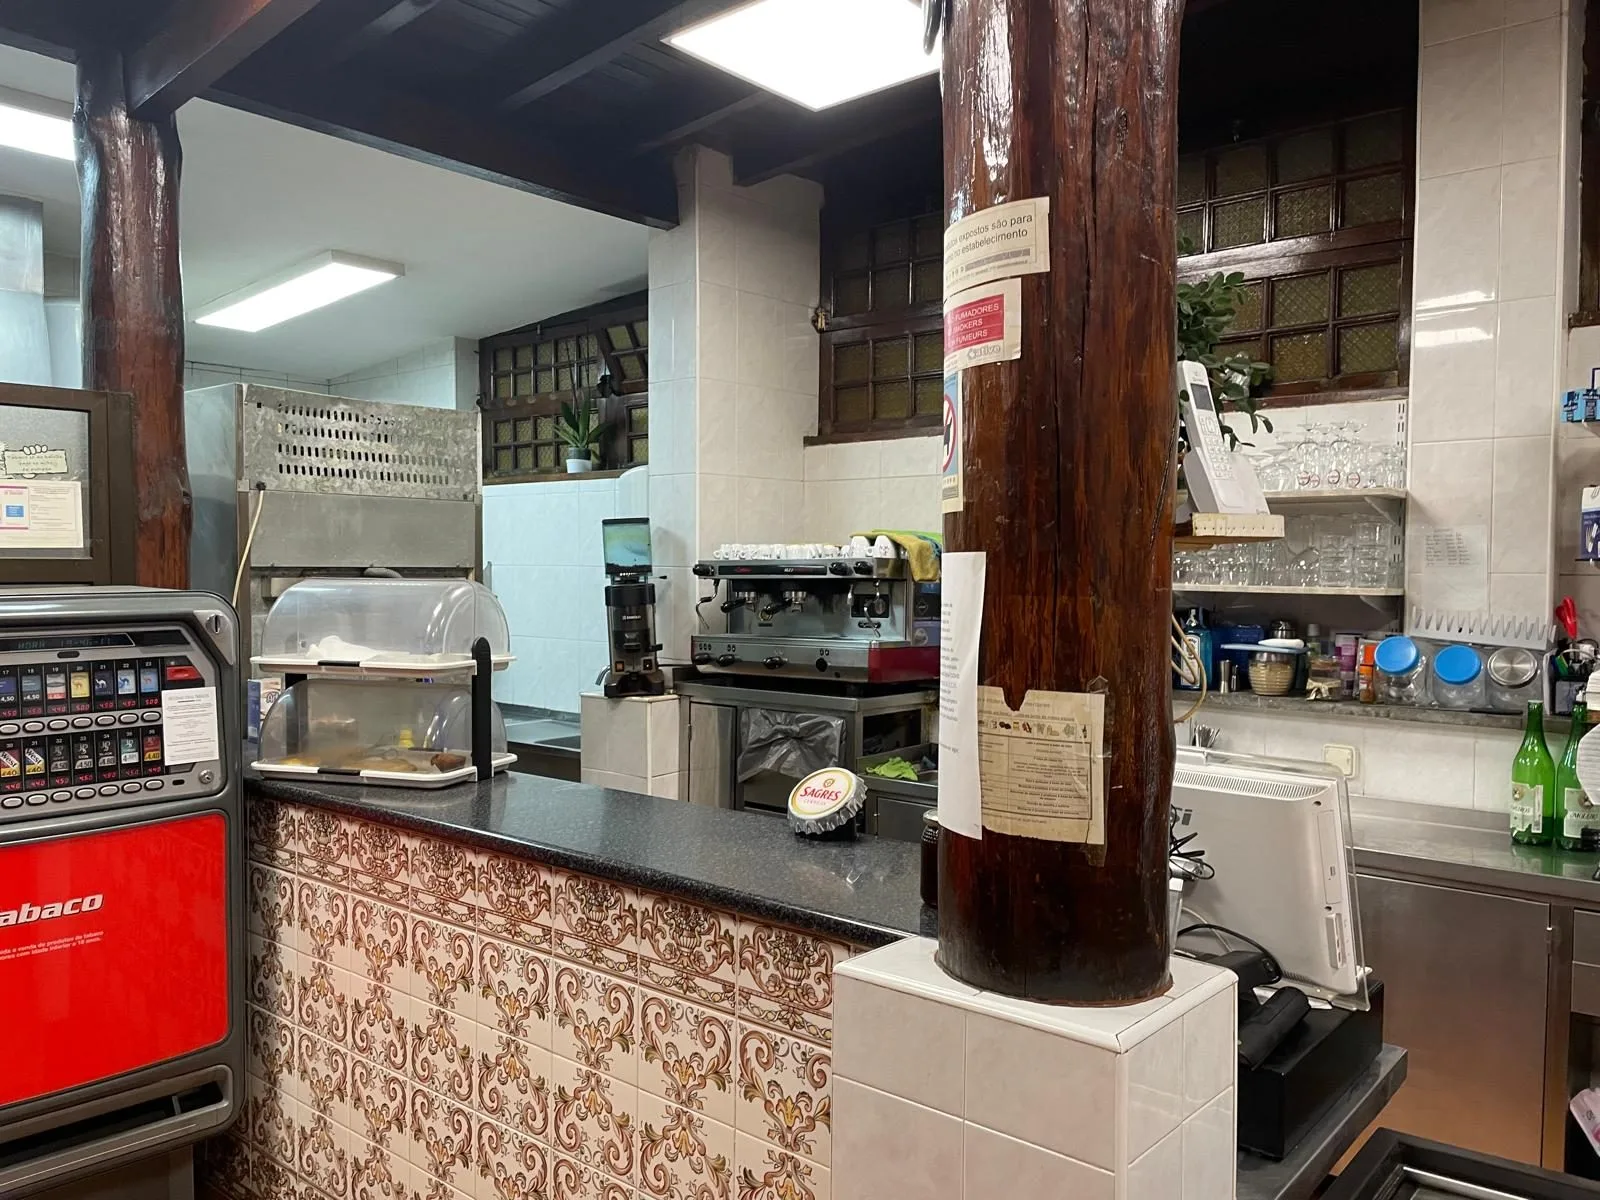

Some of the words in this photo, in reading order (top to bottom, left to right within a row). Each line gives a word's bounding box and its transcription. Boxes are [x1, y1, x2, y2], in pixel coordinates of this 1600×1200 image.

[958, 223, 990, 243] expostos
[991, 217, 1008, 231] são
[1010, 213, 1033, 227] para
[962, 228, 1028, 254] estabelecimento
[0, 751, 17, 769] West
[25, 748, 41, 765] West
[800, 786, 842, 801] SAGRES
